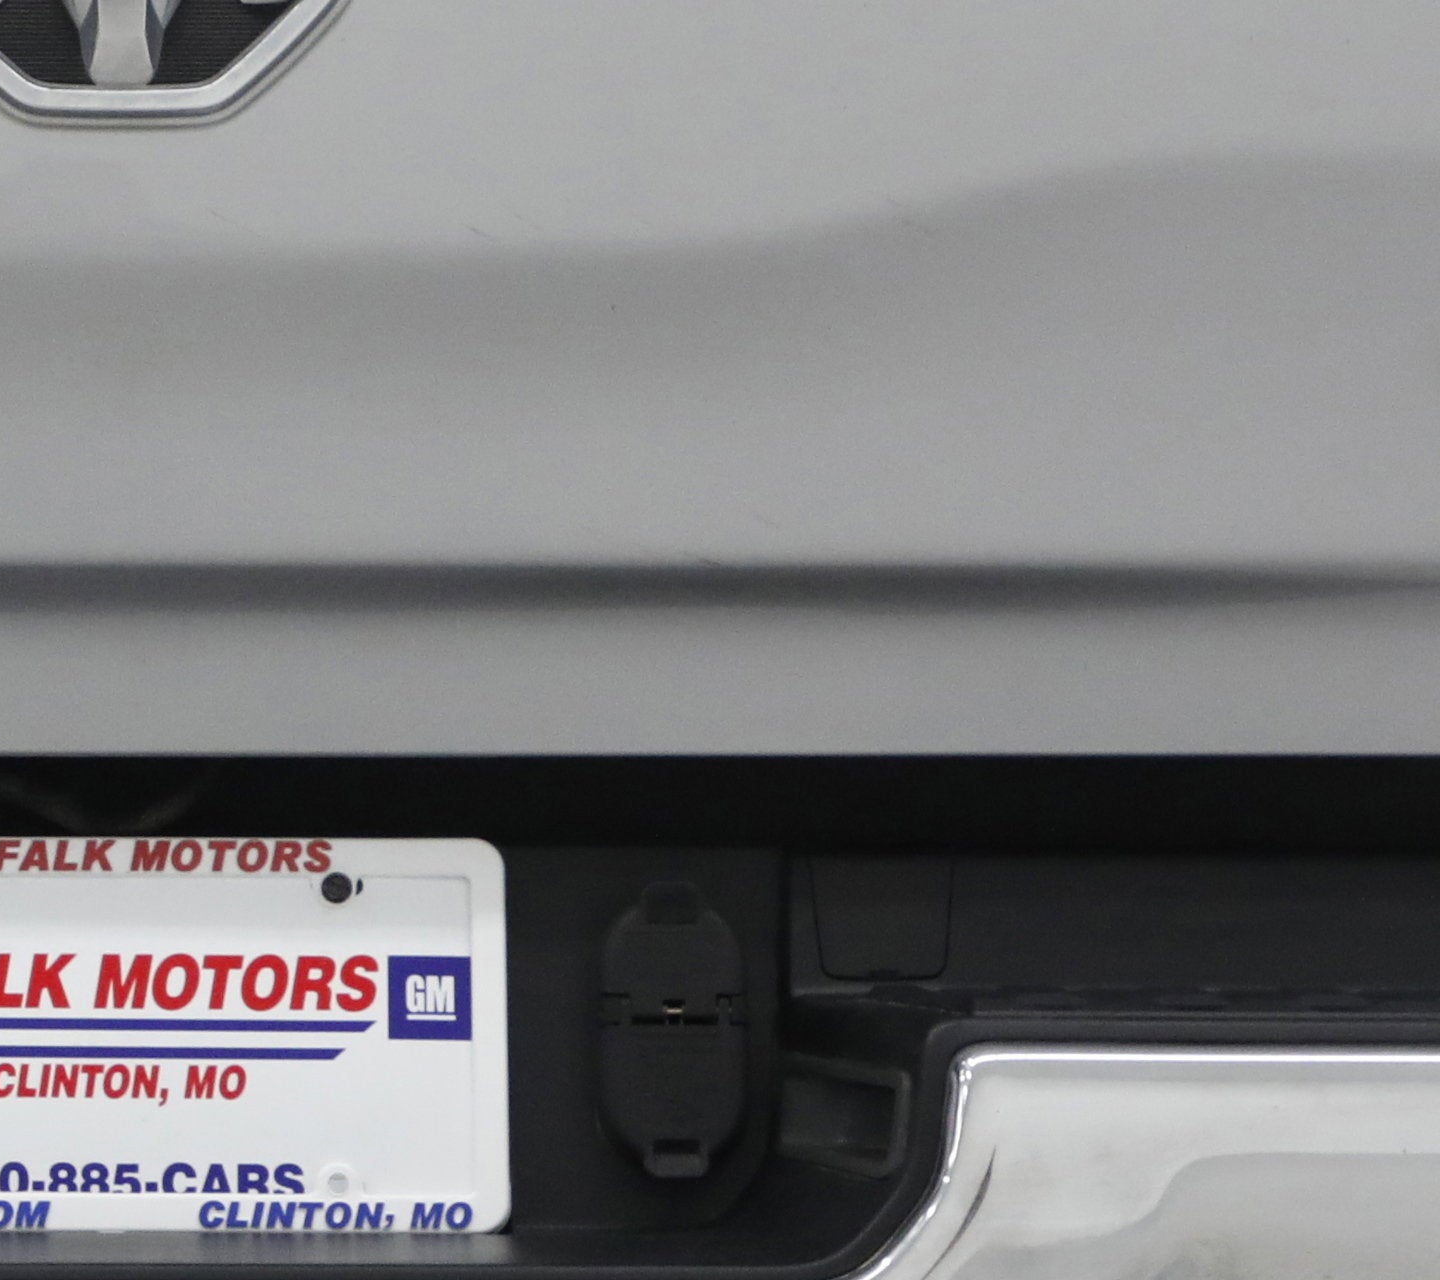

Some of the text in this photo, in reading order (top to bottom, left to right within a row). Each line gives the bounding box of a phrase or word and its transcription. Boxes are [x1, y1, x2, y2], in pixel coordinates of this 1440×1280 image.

[131, 839, 332, 873] MOTORS
[93, 953, 379, 1012] MOTORS
[404, 973, 457, 1015] GM
[184, 1064, 247, 1100] MO
[198, 1200, 474, 1231] CLINTON, MO
